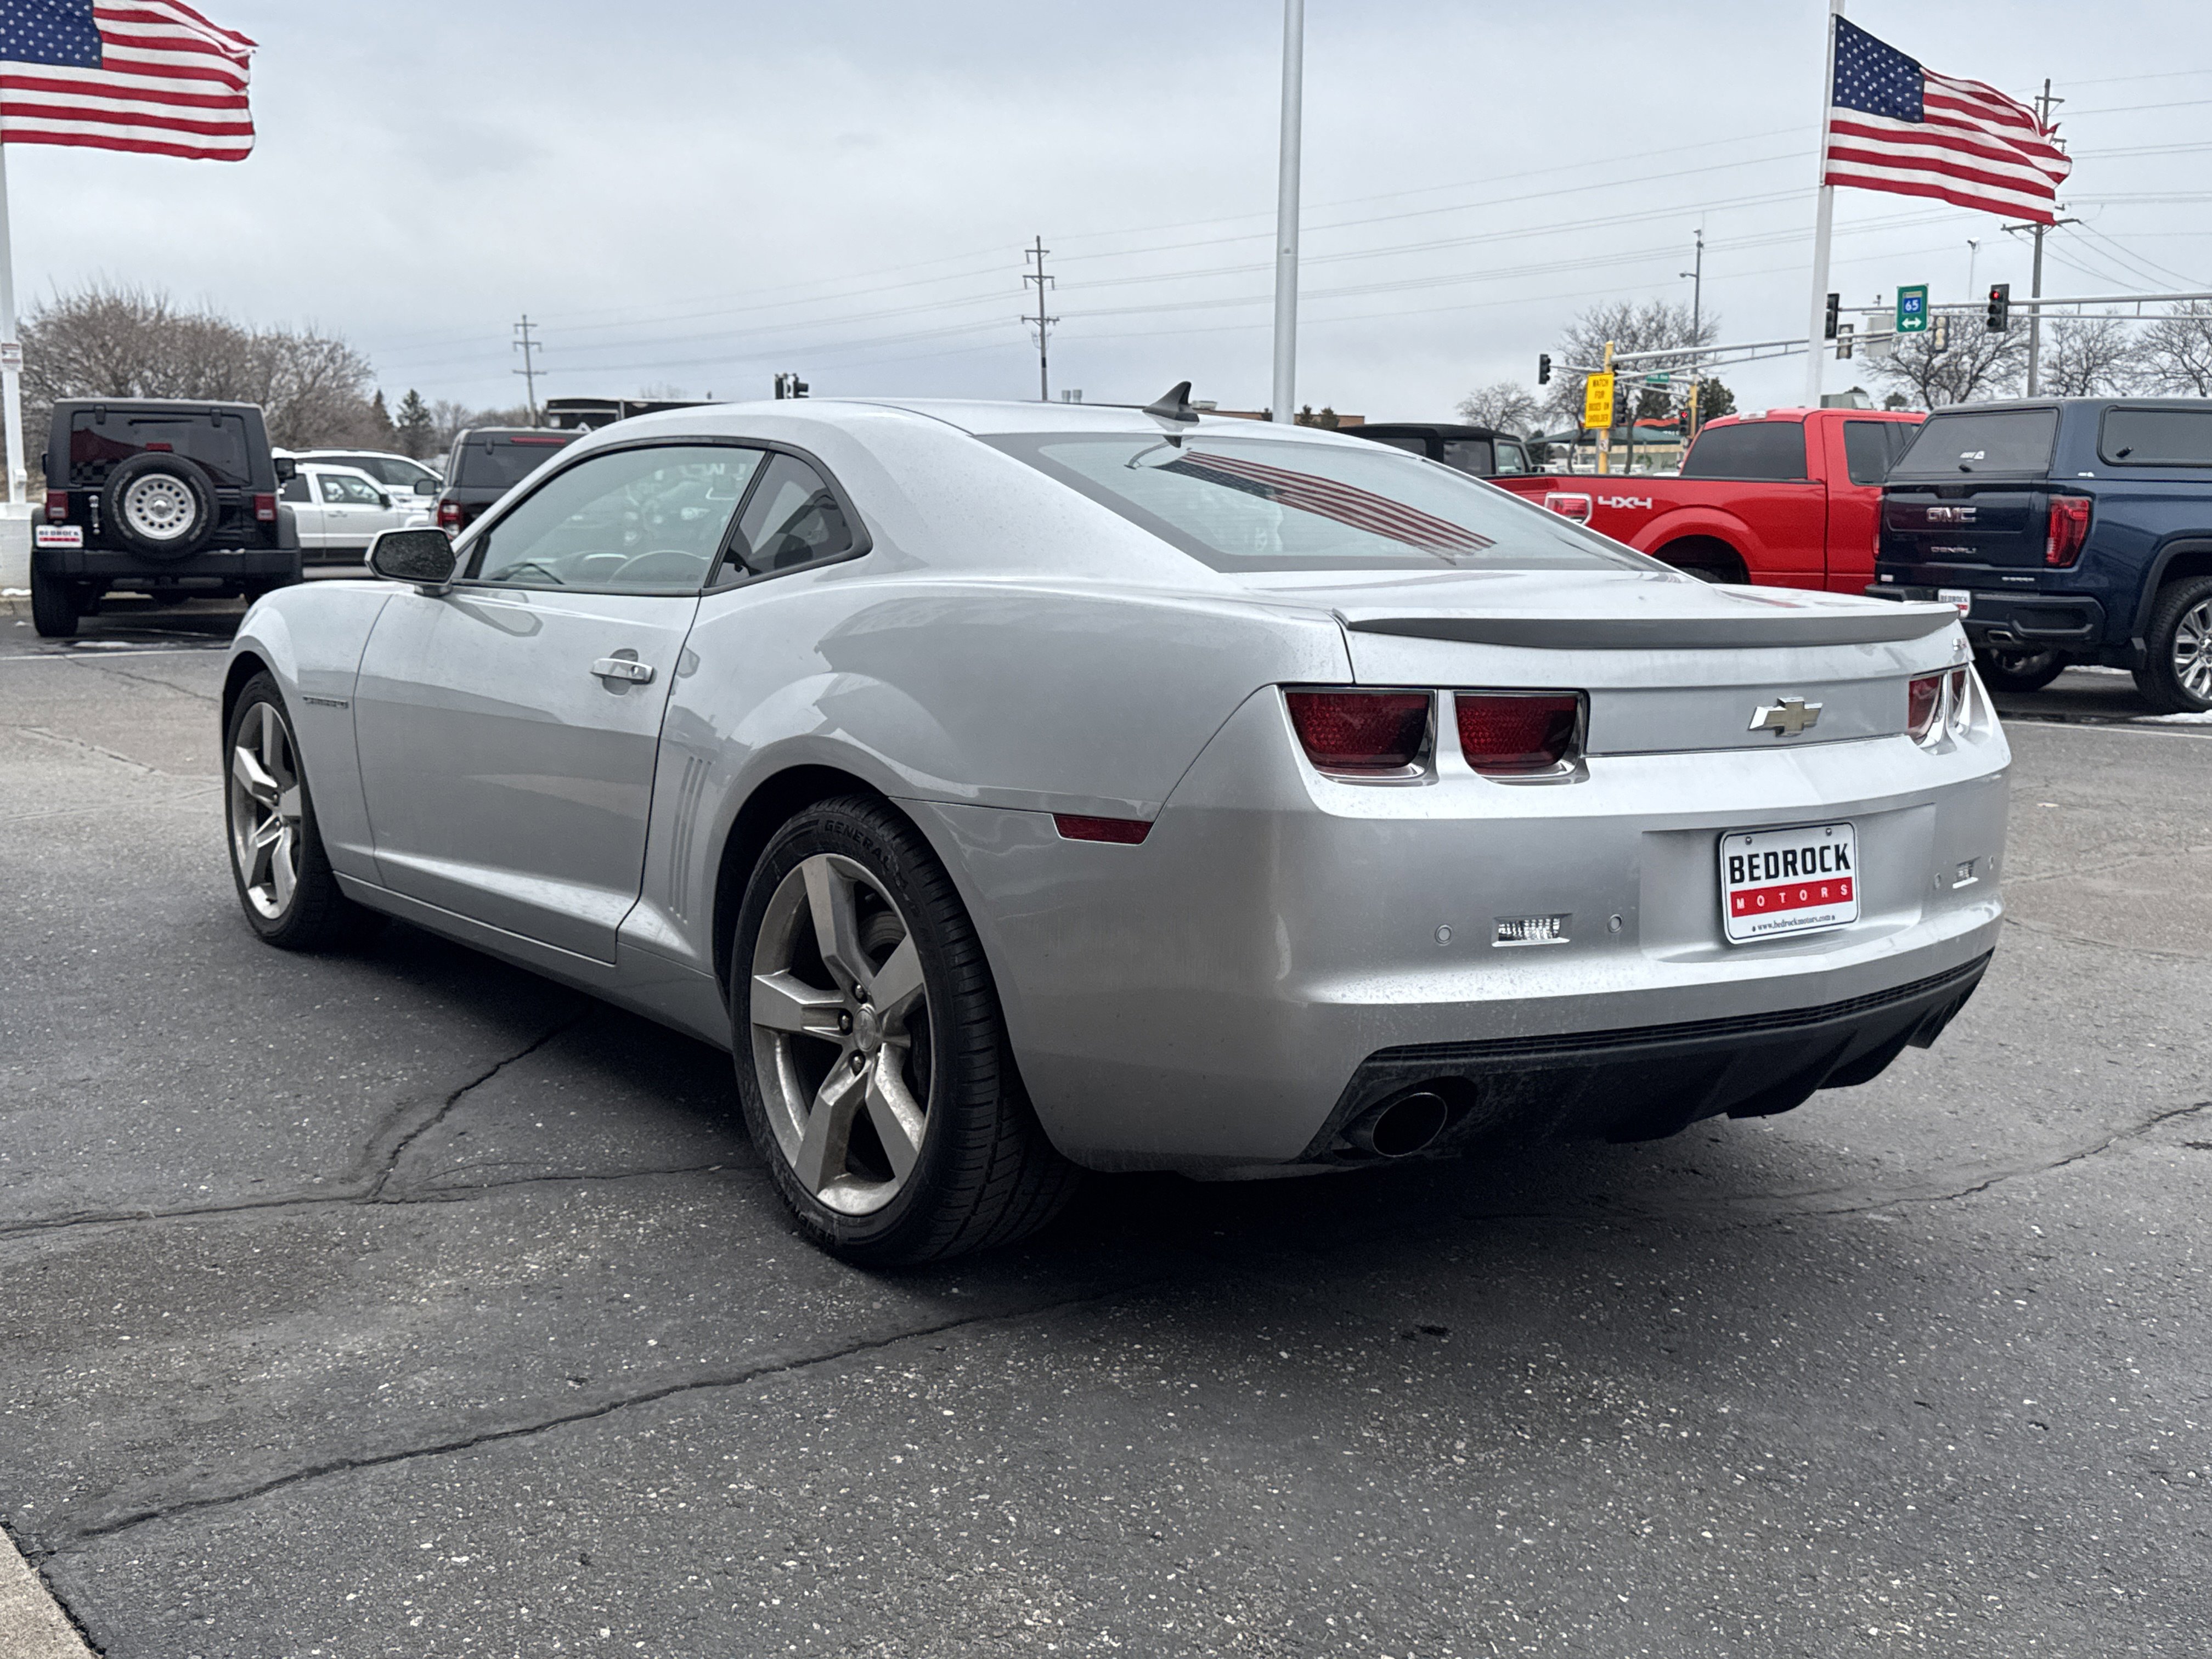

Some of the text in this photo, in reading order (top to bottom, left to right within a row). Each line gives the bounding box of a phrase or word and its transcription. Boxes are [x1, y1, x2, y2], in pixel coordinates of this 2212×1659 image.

[1905, 300, 1919, 312] 65
[1926, 507, 1977, 522] GMC
[824, 820, 890, 872] GENERAL
[1729, 843, 1851, 884] BEDROCK
[1736, 884, 1848, 910] MOTORS
[1757, 915, 1831, 930] www.bedrockmotors.com
